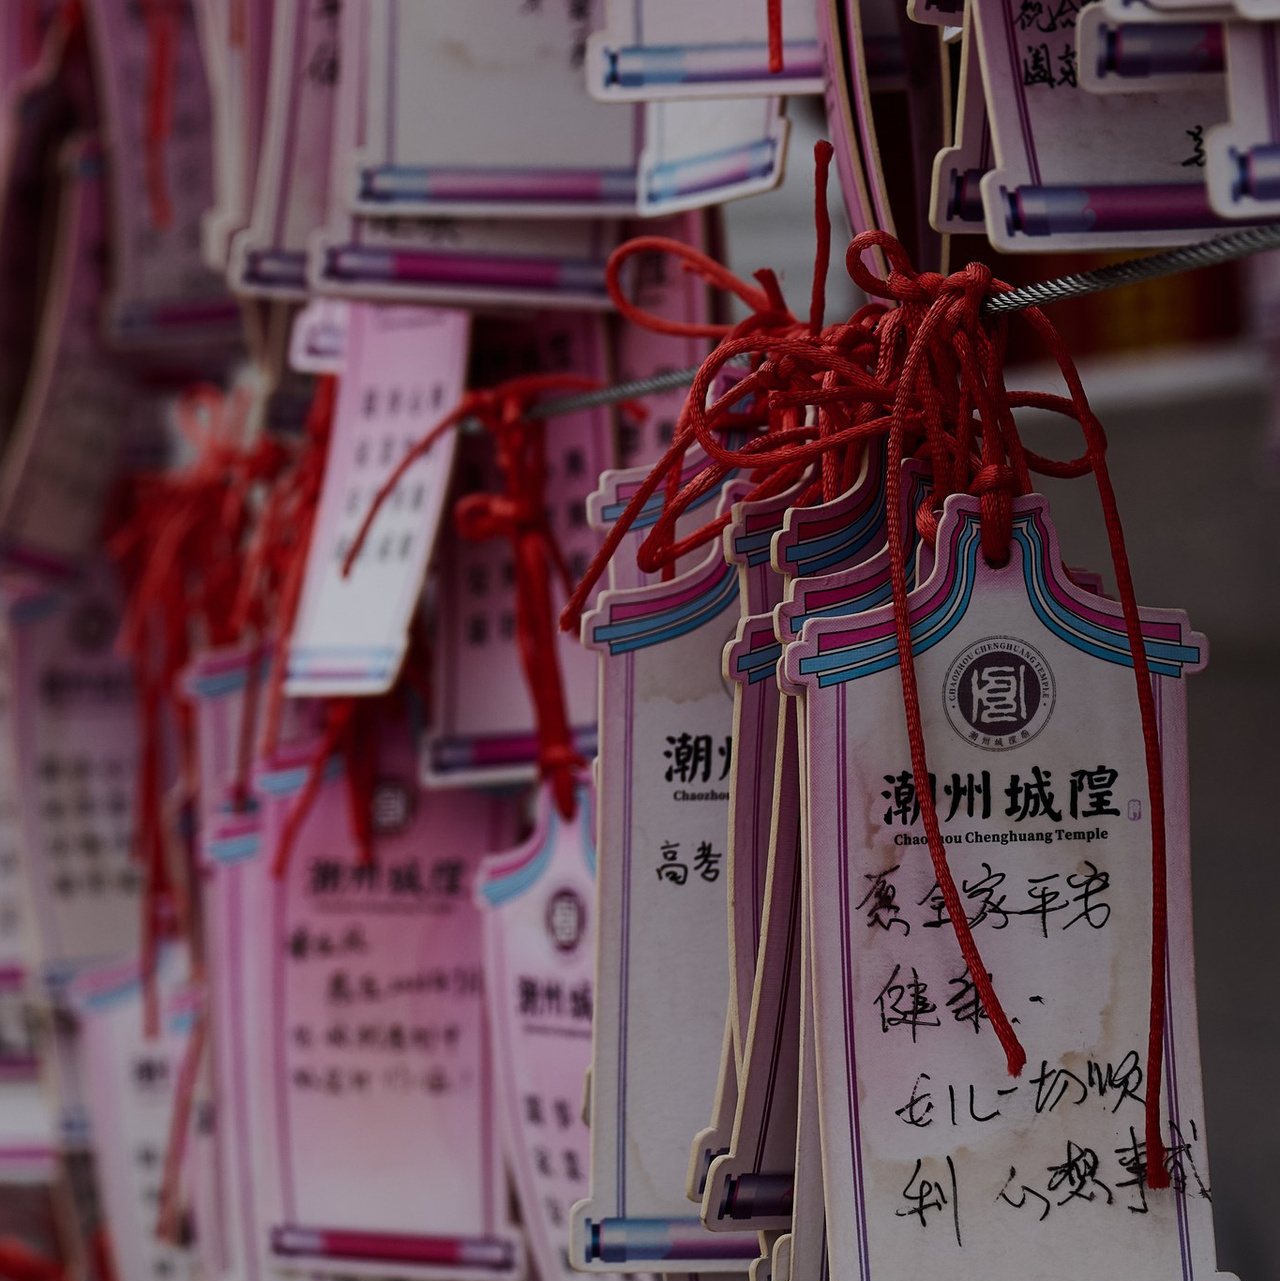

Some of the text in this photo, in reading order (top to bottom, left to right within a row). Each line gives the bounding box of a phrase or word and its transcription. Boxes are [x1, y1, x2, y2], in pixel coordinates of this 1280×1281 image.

[973, 641, 1037, 664] CHENGHUANG
[1033, 661, 1051, 699] TEMPLE
[881, 765, 1121, 826] 潮州城隍
[893, 827, 1109, 846] Chaoou Chenghuang Temple
[655, 840, 722, 886] 高考
